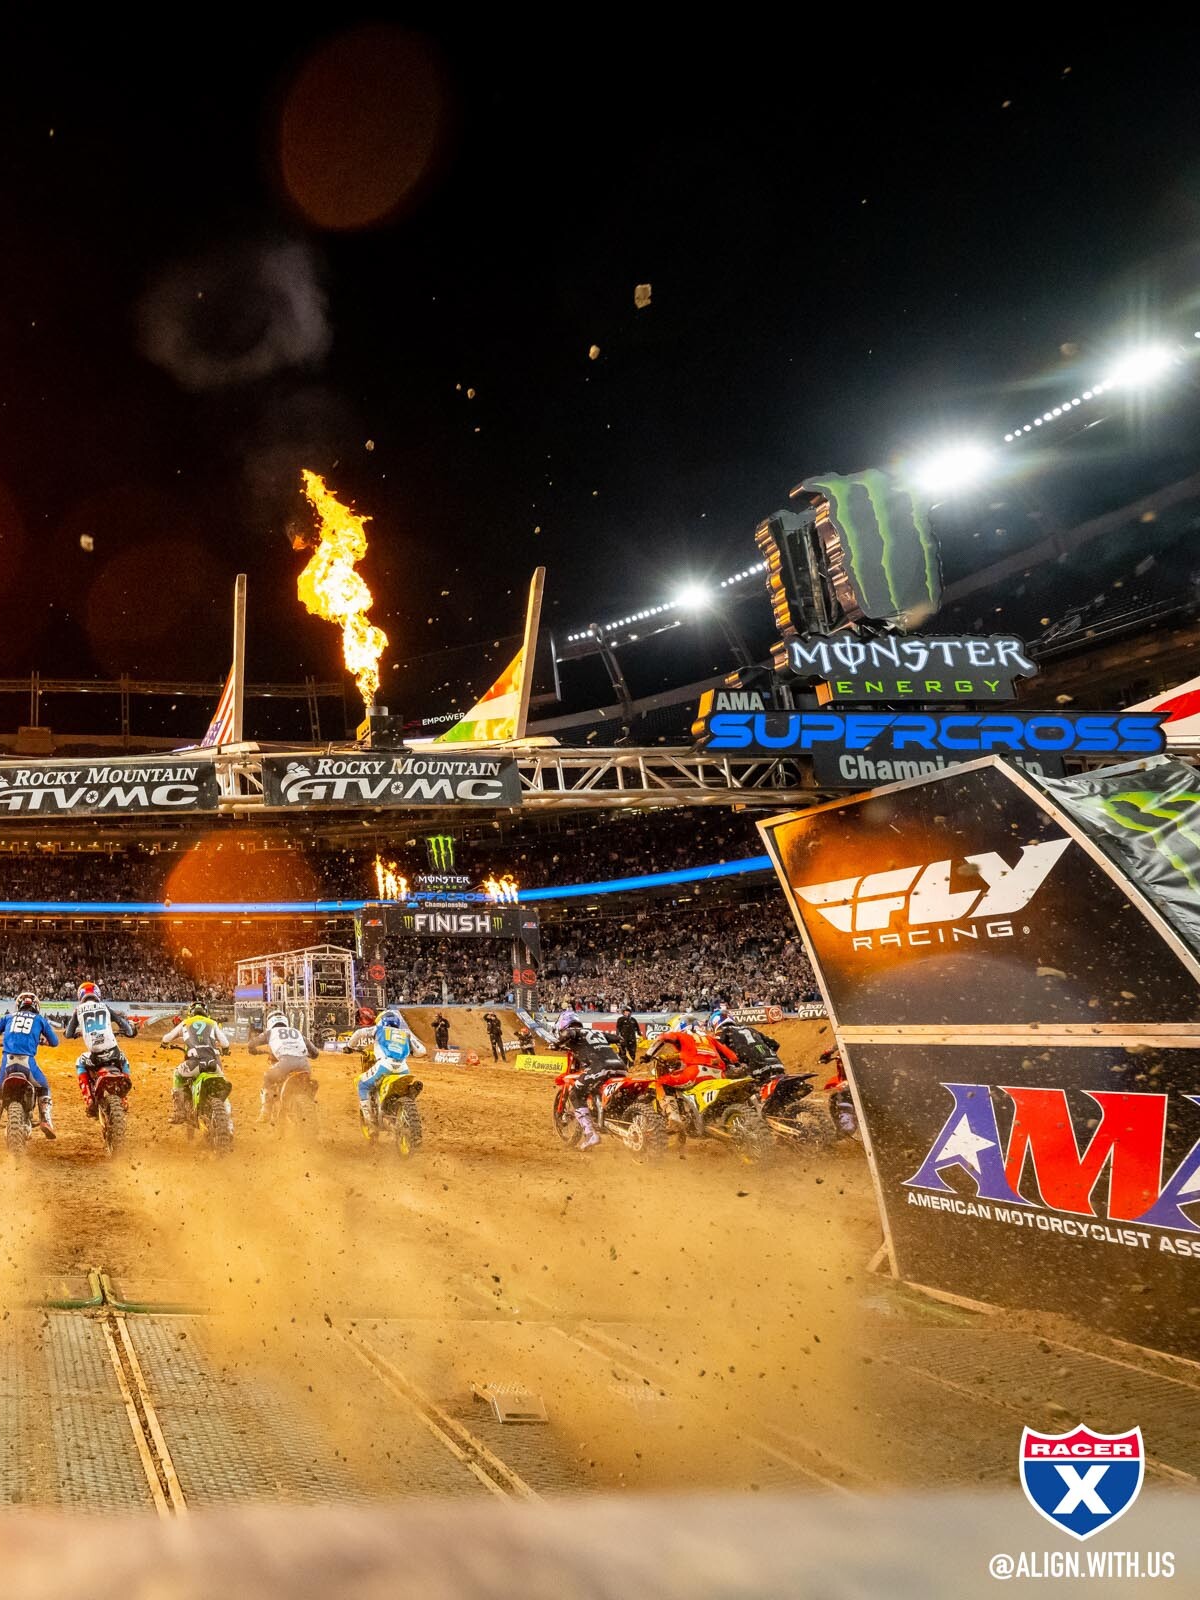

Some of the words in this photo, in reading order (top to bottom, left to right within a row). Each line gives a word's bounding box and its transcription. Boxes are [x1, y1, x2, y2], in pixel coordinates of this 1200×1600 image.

[836, 680, 1000, 694] ENERGY
[716, 692, 764, 710] AMA
[422, 711, 465, 726] EMPOWER
[706, 715, 1162, 751] SUPERCROSS
[315, 758, 386, 775] ROCKY
[388, 758, 501, 776] MOUNTAIN
[13, 769, 83, 786] ROCKY
[84, 767, 198, 784] MOUNTAIN
[794, 838, 1073, 932] FLY
[414, 914, 491, 933] FINISH
[853, 921, 1014, 951] RACING
[10, 1016, 34, 1034] 129
[83, 1010, 107, 1033] 60
[192, 1022, 207, 1035] 9
[278, 1029, 298, 1039] 80
[532, 1061, 563, 1071] Kawasaki
[907, 1192, 991, 1219] AMERICAN
[994, 1207, 1152, 1249] MOTORCYCLIST
